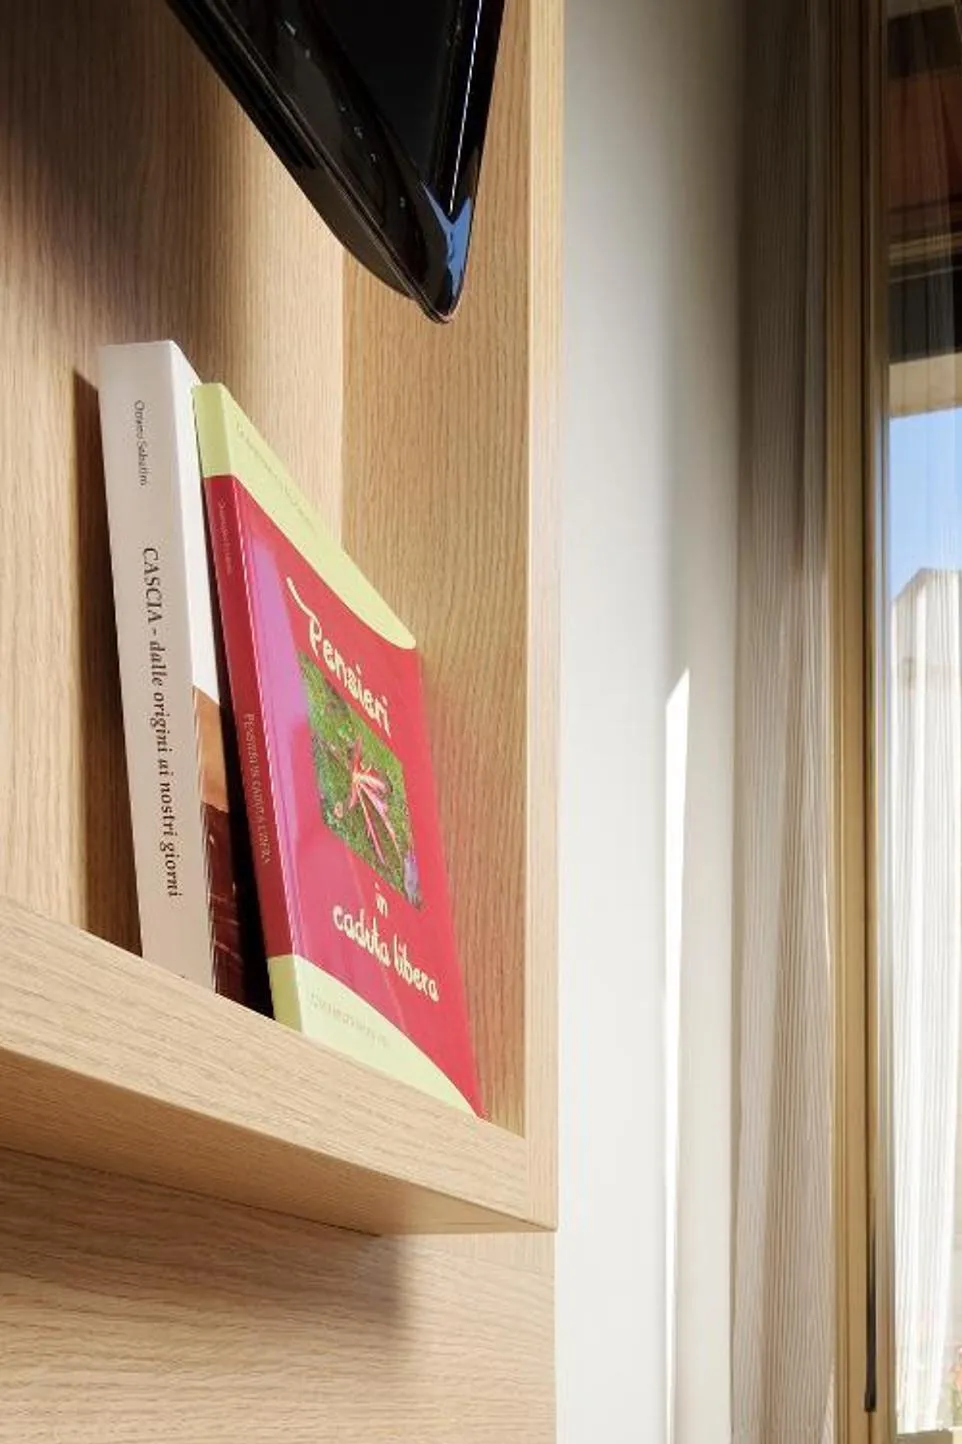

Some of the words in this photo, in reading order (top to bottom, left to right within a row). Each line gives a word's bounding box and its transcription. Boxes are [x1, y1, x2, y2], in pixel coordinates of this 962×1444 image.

[143, 547, 163, 623] CASCIA
[149, 639, 167, 686] dalle
[286, 576, 392, 739] Pensieri
[150, 690, 172, 752] origini
[160, 781, 178, 836] nostri
[160, 841, 183, 898] giorni
[374, 881, 389, 919] in
[333, 905, 391, 968] caduta
[394, 933, 440, 1002] libera
